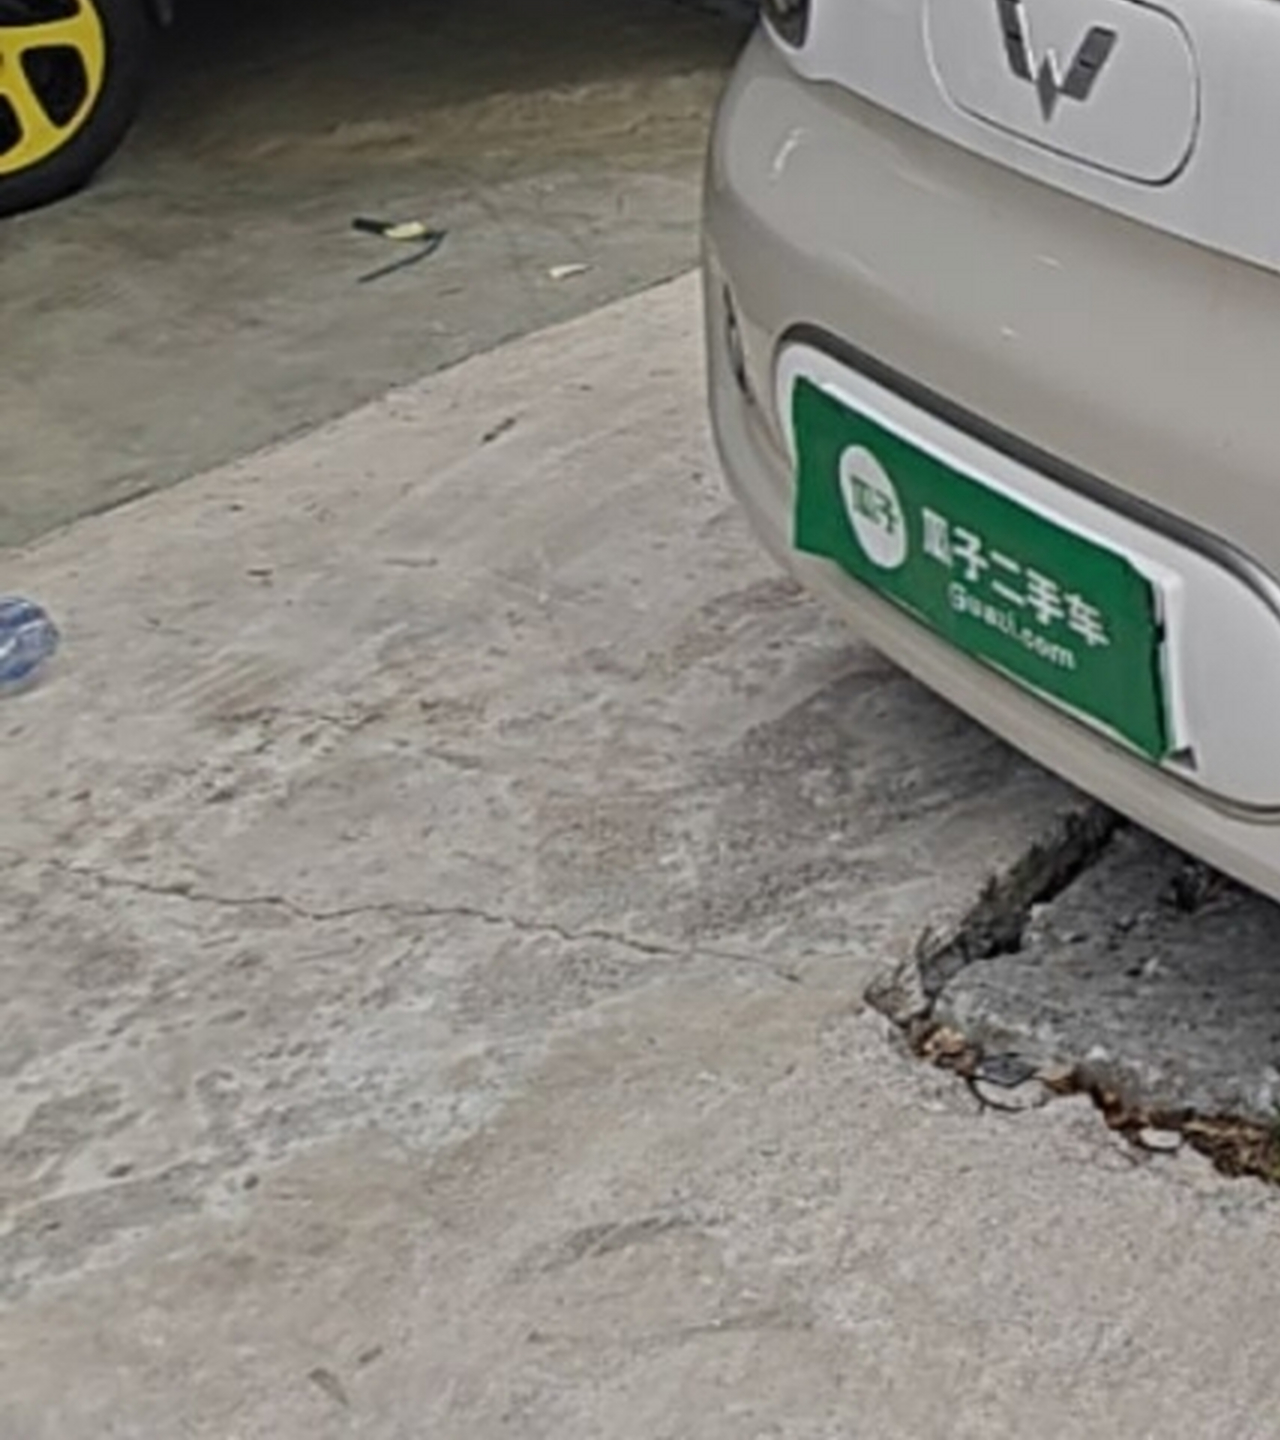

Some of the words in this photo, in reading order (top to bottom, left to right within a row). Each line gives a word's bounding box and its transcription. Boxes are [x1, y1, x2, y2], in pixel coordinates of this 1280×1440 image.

[922, 506, 1110, 647] 瓜子二手车
